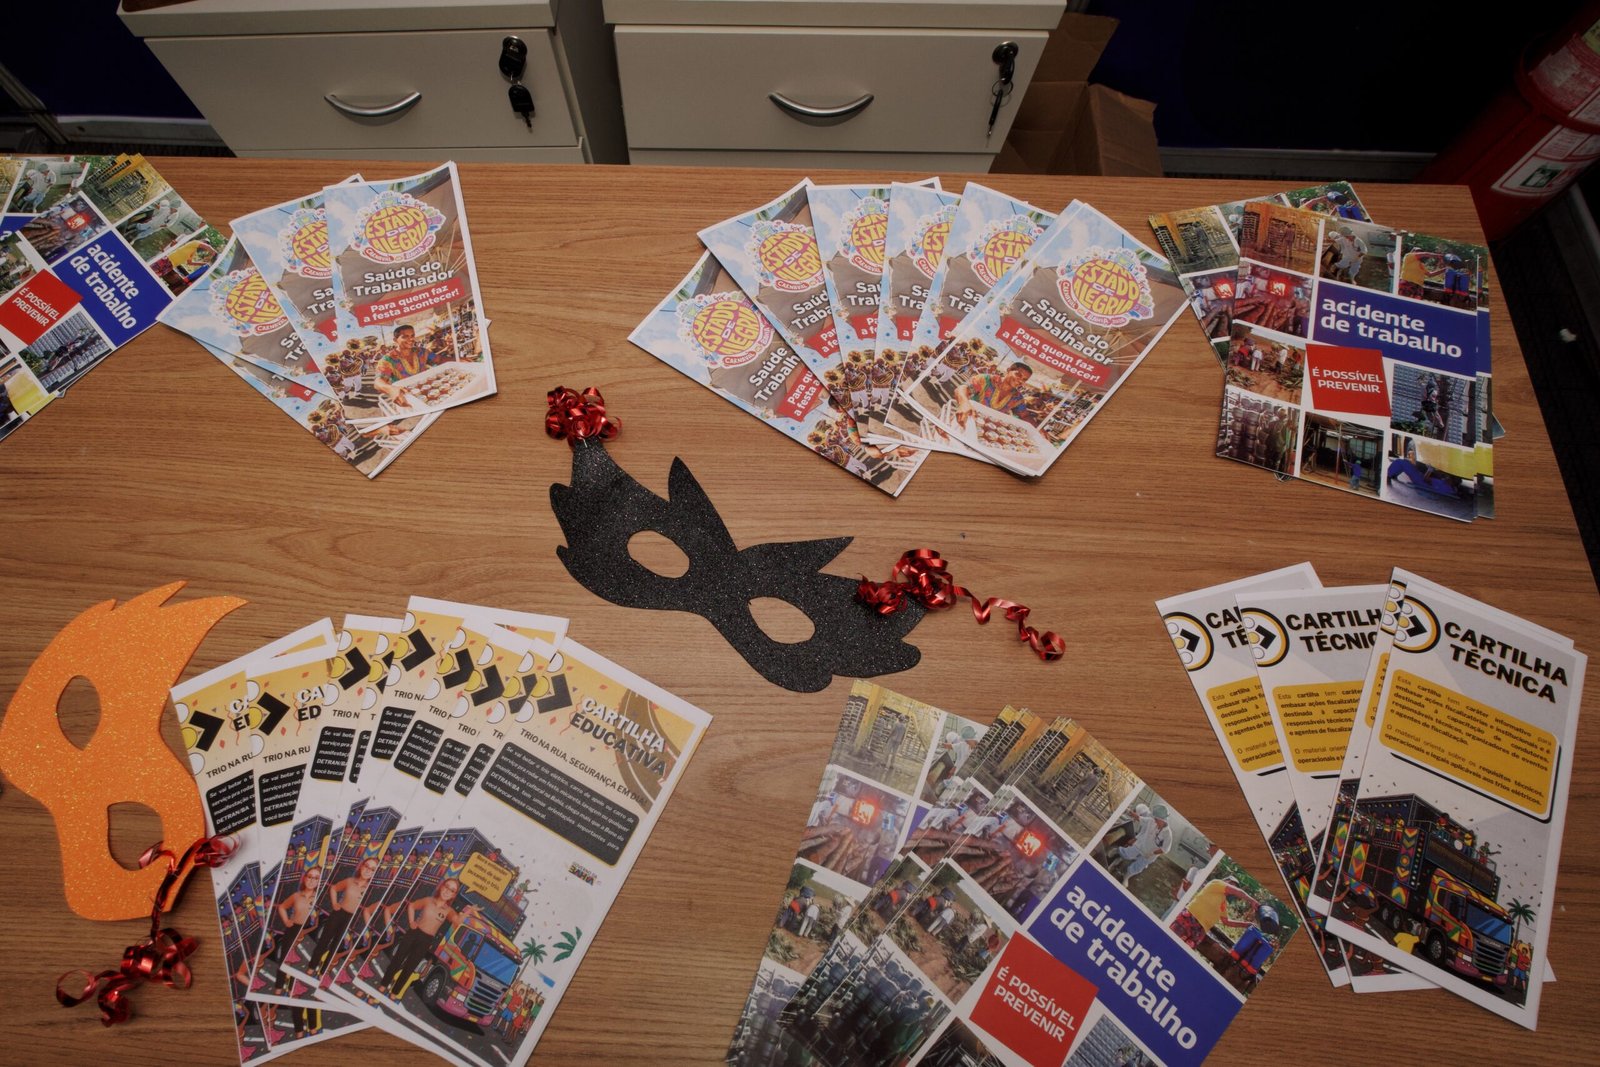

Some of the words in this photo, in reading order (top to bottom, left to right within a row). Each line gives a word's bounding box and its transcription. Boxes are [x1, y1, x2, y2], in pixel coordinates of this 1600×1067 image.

[366, 208, 425, 239] ESTADO
[87, 243, 140, 300] acidente
[353, 269, 455, 296] Trabalhador
[364, 266, 415, 283] Saúde
[420, 261, 441, 273] do
[1075, 262, 1140, 300] ESTADO
[19, 287, 29, 296] É
[25, 292, 61, 321] POSSÍVEL
[69, 254, 90, 275] de
[85, 270, 137, 330] trabalho
[363, 315, 370, 323] a
[372, 309, 401, 321] festa
[403, 289, 460, 313] acontecer!
[370, 302, 396, 313] Para
[399, 292, 429, 306] quem
[431, 284, 449, 296] faz
[793, 290, 828, 315] Saúd
[1073, 279, 1133, 316] ALEGRIA
[1092, 283, 1115, 296] DE
[13, 297, 50, 327] PREVENIR
[698, 301, 740, 352] ESTADO
[1037, 299, 1085, 336] Saúde
[1087, 330, 1109, 350] do
[1322, 298, 1425, 332] acidente
[722, 320, 736, 339] DE
[820, 327, 836, 341] Par
[1019, 300, 1114, 366] Trabalhador
[1320, 314, 1350, 333] de
[1357, 321, 1462, 358] trabalho
[1002, 330, 1010, 339] a
[1010, 334, 1038, 355] festa
[1038, 351, 1101, 383] acontecer!
[1016, 327, 1040, 346] Para
[1042, 340, 1074, 364] quem
[1075, 357, 1095, 372] faz
[749, 347, 788, 387] Saúde
[754, 354, 800, 401] Trabalh
[1312, 367, 1320, 377] É
[1323, 369, 1383, 384] POSSÍVEL
[787, 383, 806, 405] Para
[797, 388, 817, 412] festa
[1318, 379, 1381, 394] PREVENIR
[794, 408, 802, 416] a
[1285, 608, 1383, 631] CARTILH
[1300, 630, 1378, 653] TÉCNIC
[1444, 621, 1568, 687] CARTILHA
[1417, 683, 1441, 698] cartilha
[1449, 643, 1557, 704] TÉCNICA
[393, 690, 414, 699] TRIO
[427, 704, 447, 718] TRIO
[331, 709, 352, 718] TRIO
[456, 722, 477, 735] TRIO
[582, 697, 667, 753] CARTILHA
[263, 752, 282, 763] TRIO
[284, 748, 297, 758] NA
[297, 745, 311, 754] RU
[570, 712, 667, 776] EDUCATIVA
[206, 763, 226, 778] TRIO
[227, 757, 240, 769] NA
[241, 750, 253, 762] RU
[519, 728, 539, 744] TRIO
[537, 738, 551, 751] NA
[567, 756, 617, 790] SEGURANÇA
[616, 784, 631, 796] EM
[1066, 885, 1176, 992] acidente
[1050, 907, 1085, 944] de
[1086, 938, 1198, 1050] trabalho
[993, 984, 1066, 1043] PREVENIR
[997, 966, 1010, 981] É
[1009, 975, 1076, 1031] POSSÍVEL
